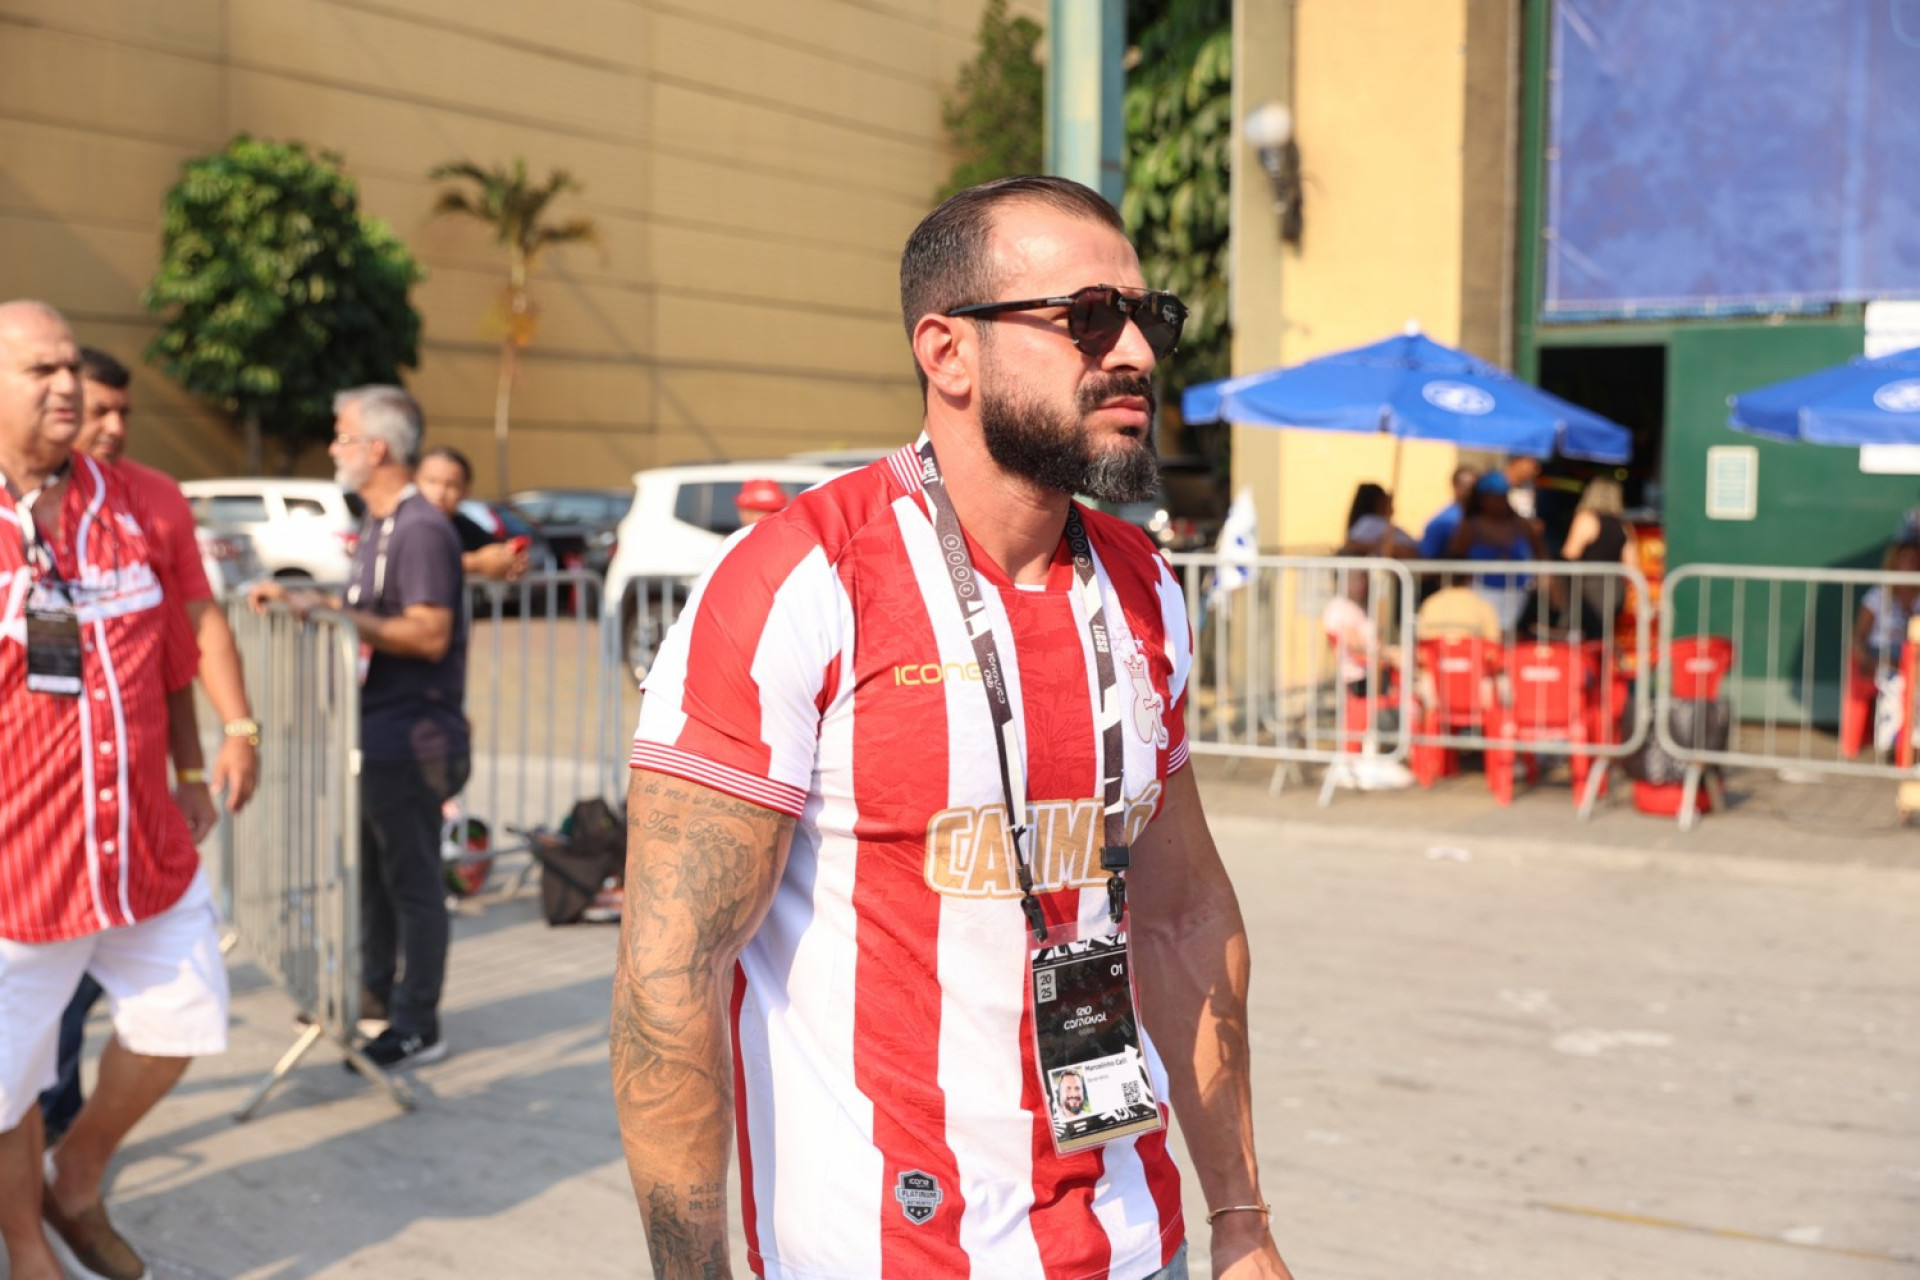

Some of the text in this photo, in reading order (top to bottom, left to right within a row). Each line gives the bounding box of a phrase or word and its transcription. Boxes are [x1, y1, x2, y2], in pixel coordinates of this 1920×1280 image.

[925, 780, 1162, 898] CAIMÓ
[1110, 963, 1123, 976] 01
[1040, 974, 1052, 985] 20
[1041, 987, 1052, 998] 25
